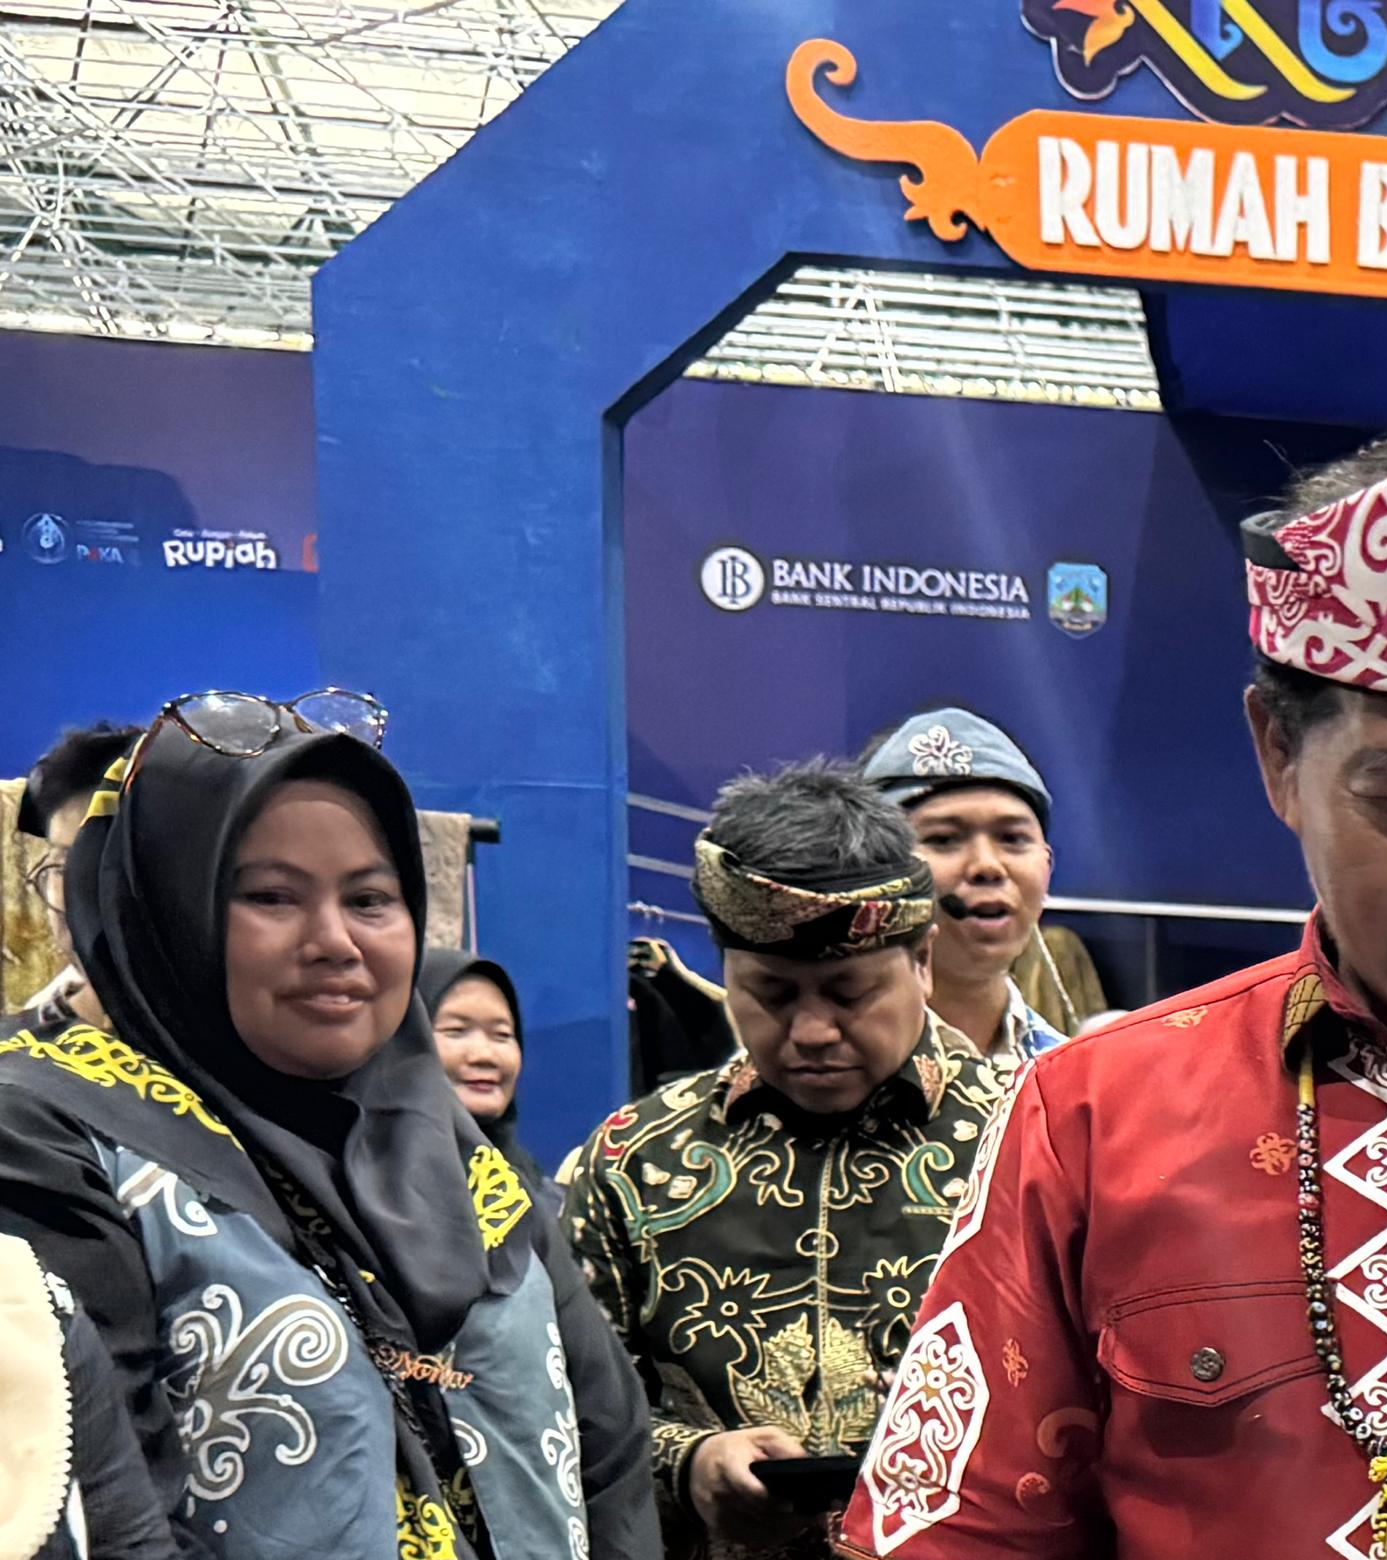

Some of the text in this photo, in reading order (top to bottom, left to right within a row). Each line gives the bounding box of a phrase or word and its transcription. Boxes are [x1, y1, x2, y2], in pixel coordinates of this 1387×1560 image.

[1037, 136, 1330, 264] RUMAH
[162, 540, 277, 569] Rupiah
[772, 560, 1029, 603] BANK INDONESIA
